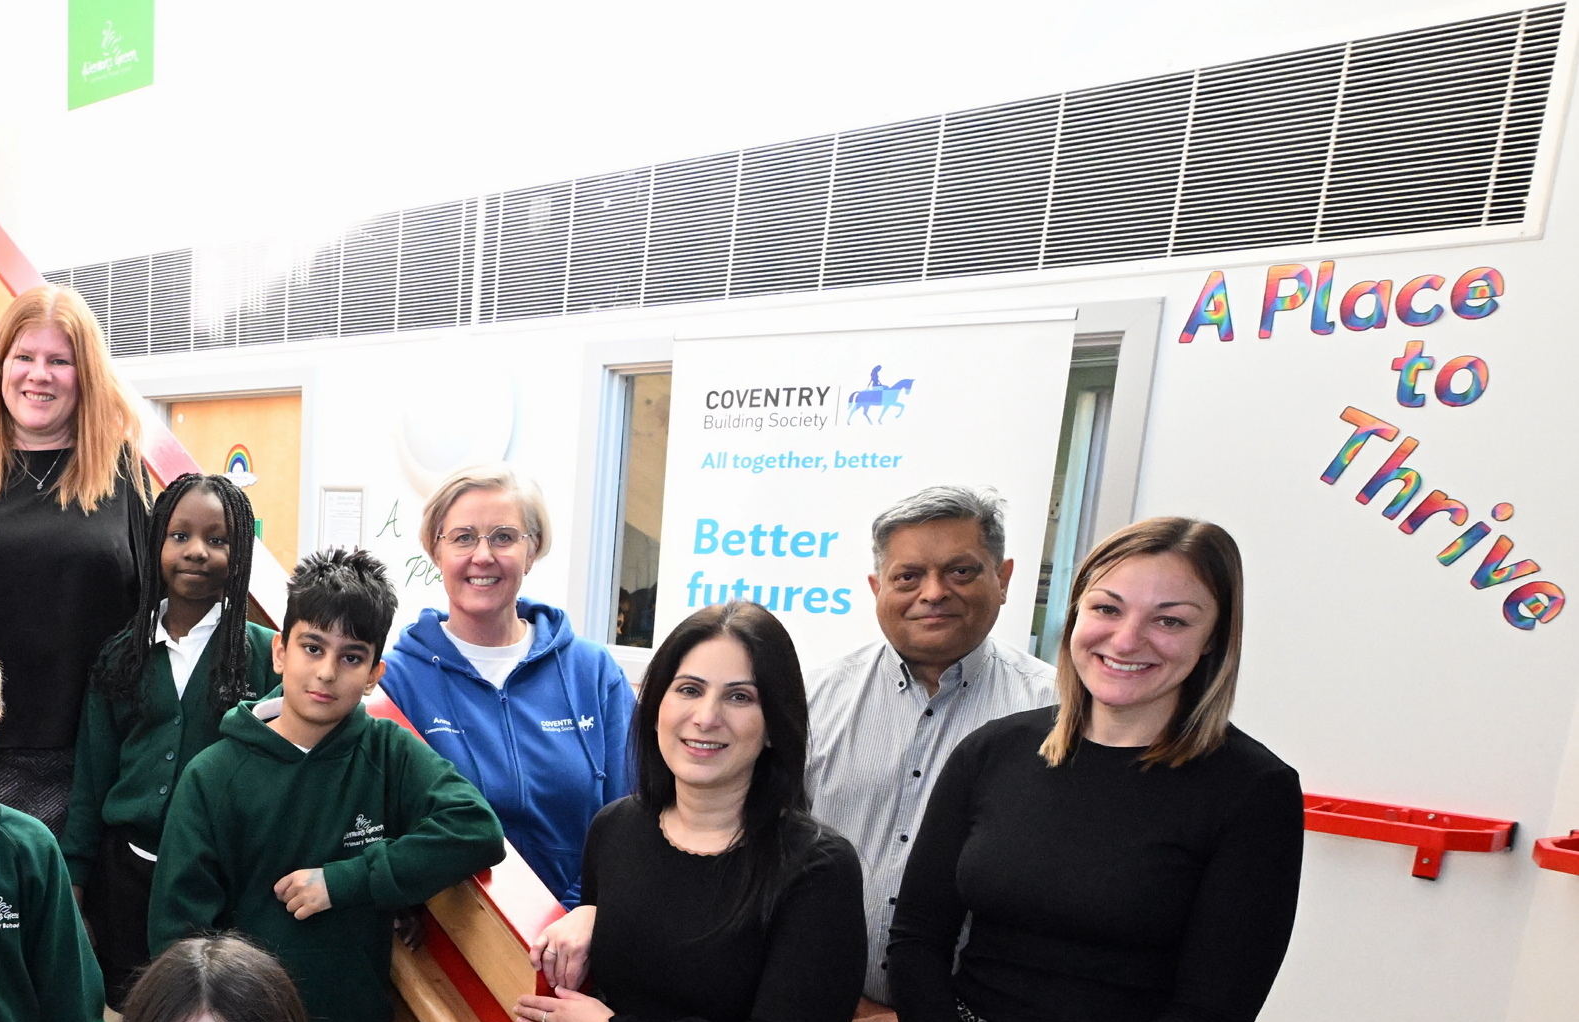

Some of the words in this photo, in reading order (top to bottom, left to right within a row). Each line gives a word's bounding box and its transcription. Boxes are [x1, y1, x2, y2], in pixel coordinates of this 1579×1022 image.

[1179, 270, 1234, 343] A
[1258, 260, 1505, 339] Place
[1391, 340, 1489, 408] to
[705, 386, 831, 410] COVENTRY
[703, 413, 763, 432] Building
[768, 412, 828, 431] Society
[700, 451, 728, 469] All
[732, 450, 828, 474] together,
[833, 450, 903, 469] better
[1320, 406, 1566, 631] Thrive
[693, 518, 840, 558] Better
[405, 555, 443, 588] Pla
[686, 570, 852, 616] futures
[540, 718, 574, 727] COVENTR
